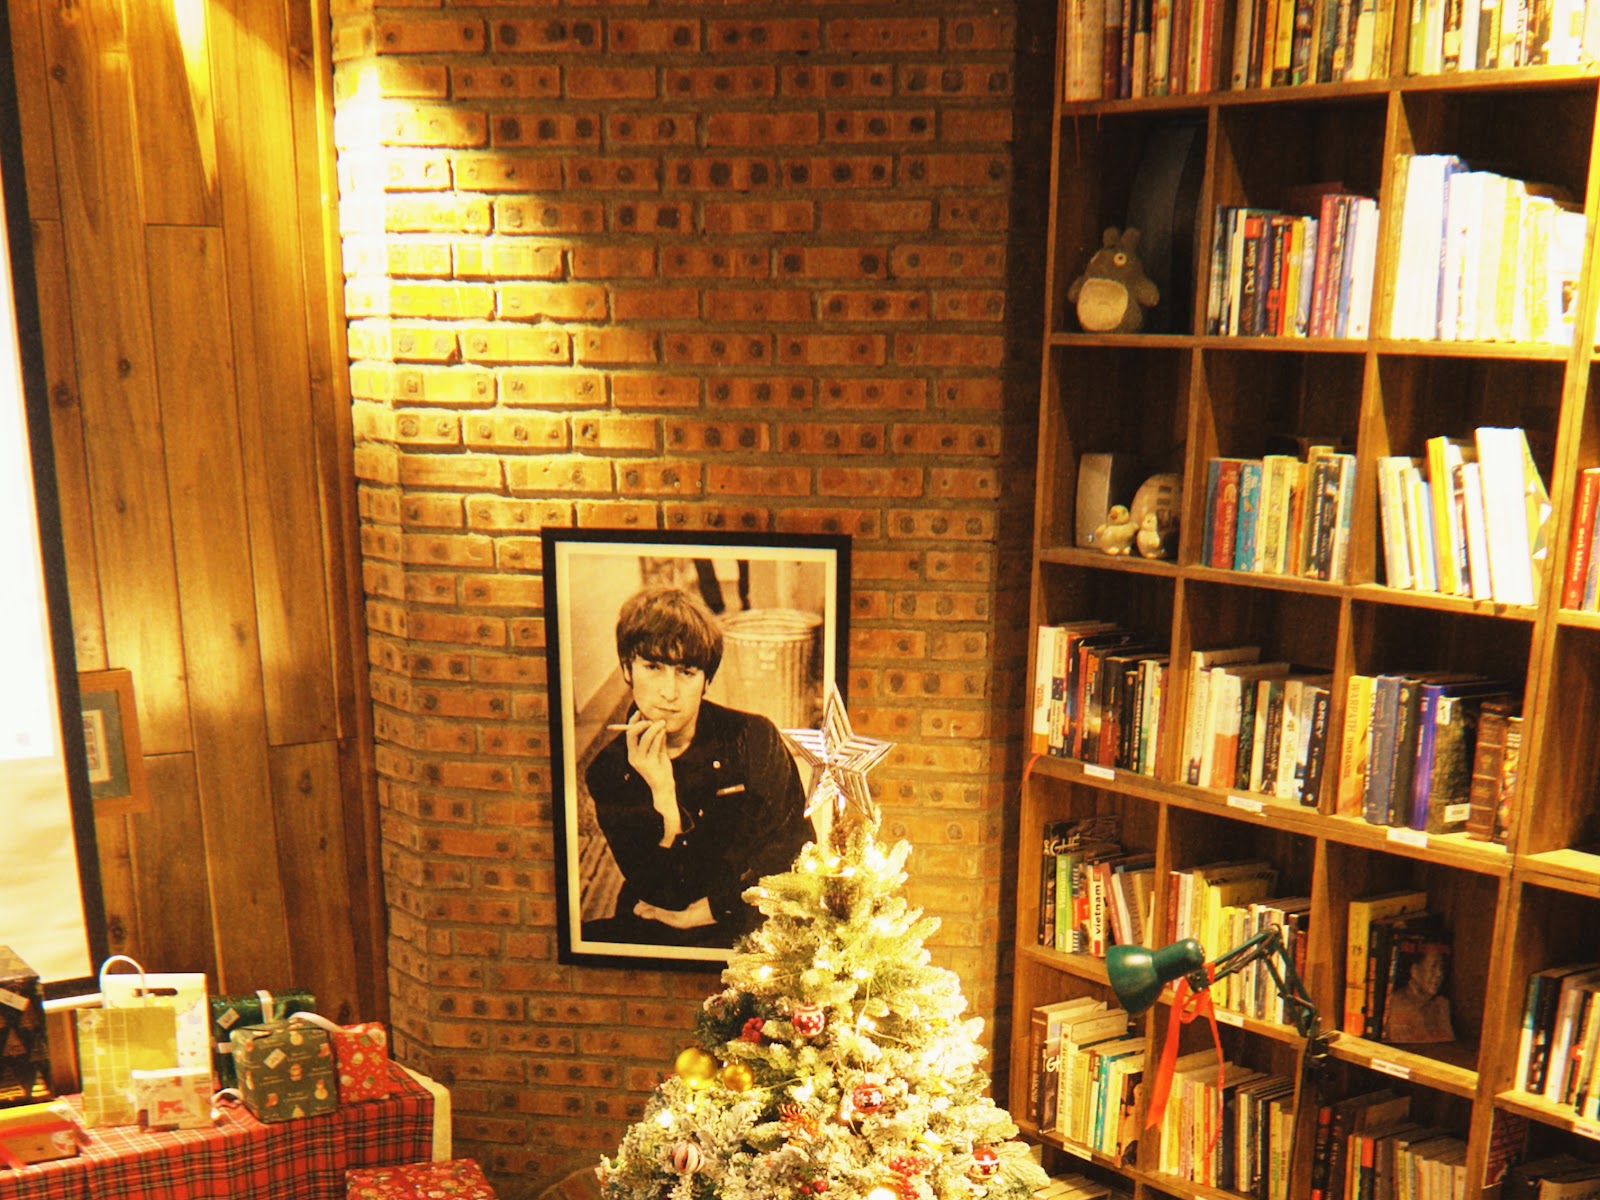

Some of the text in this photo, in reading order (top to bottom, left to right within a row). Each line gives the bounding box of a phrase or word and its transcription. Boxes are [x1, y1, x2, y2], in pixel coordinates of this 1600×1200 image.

[1315, 700, 1327, 739] GREY
[1347, 682, 1360, 733] WARPATH
[1093, 884, 1101, 935] vietnam
